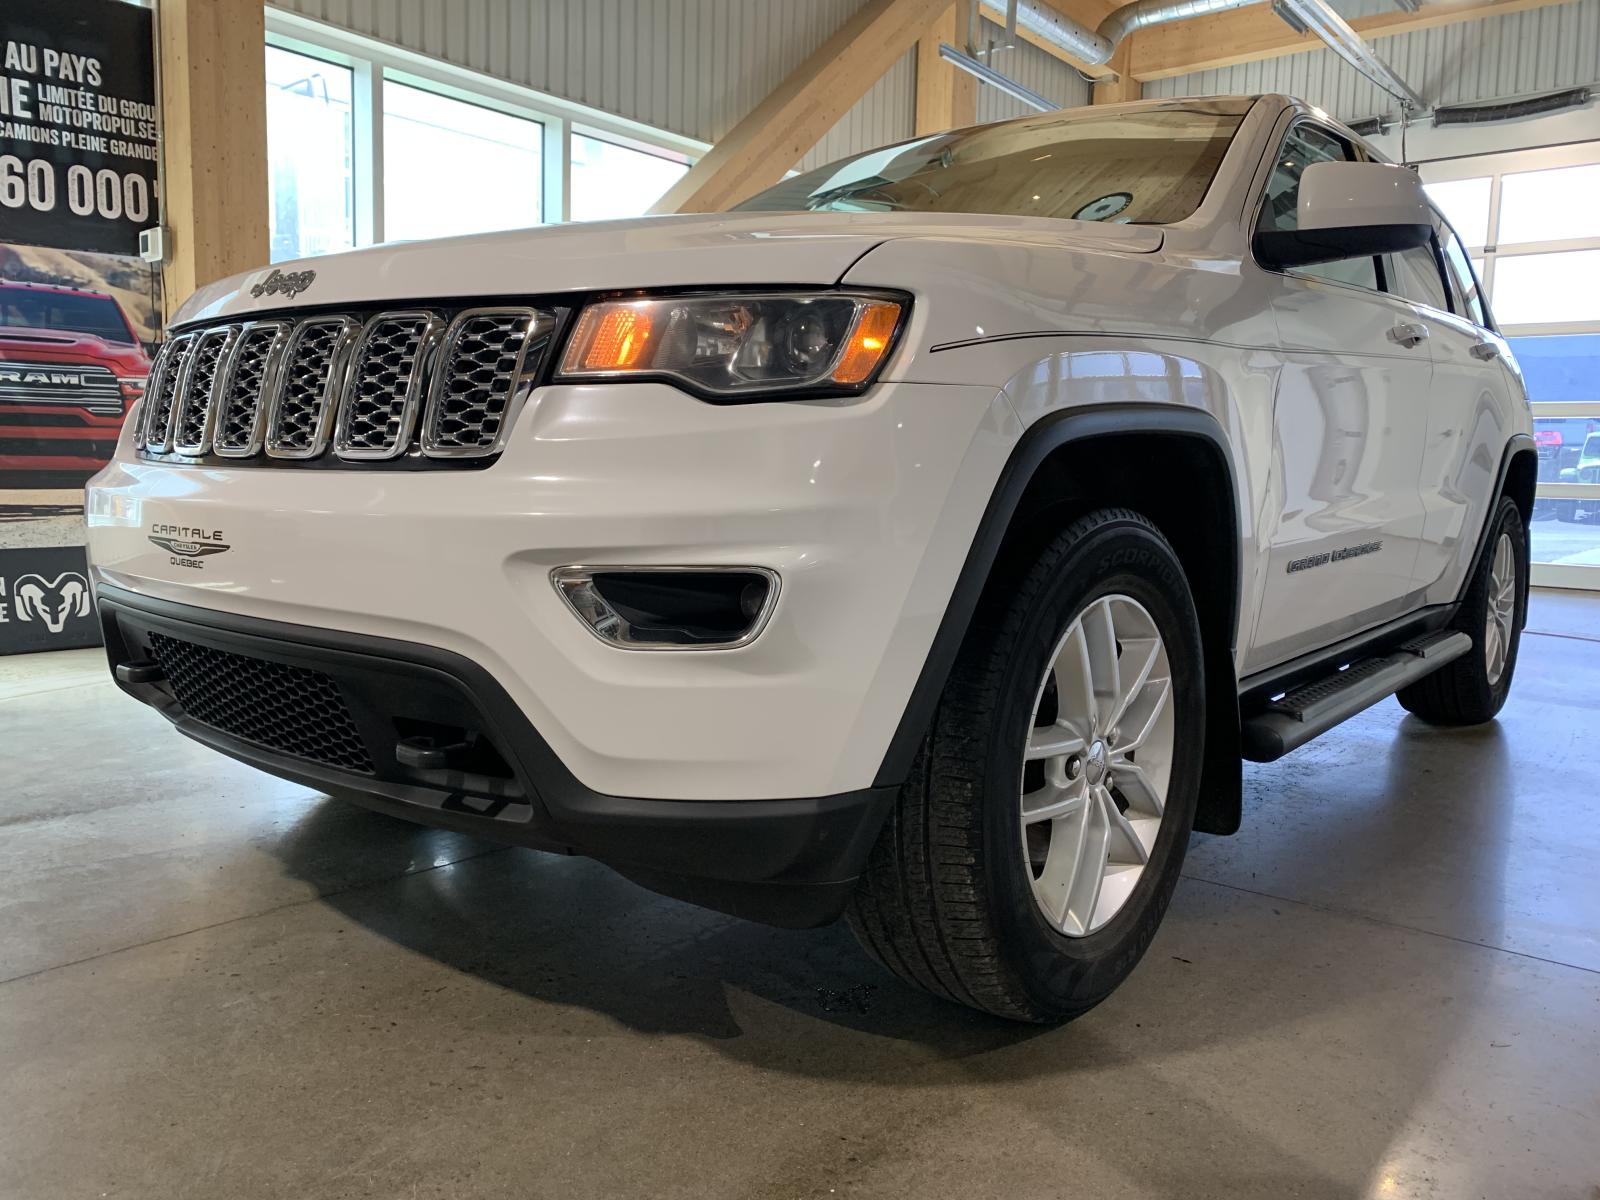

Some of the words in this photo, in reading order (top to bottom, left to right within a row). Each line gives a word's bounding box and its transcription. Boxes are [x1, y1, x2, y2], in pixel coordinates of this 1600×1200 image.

[5, 41, 37, 73] AU
[43, 48, 101, 86] PAYS
[37, 83, 95, 111] LIMITÉE
[98, 94, 117, 114] DU
[0, 120, 59, 146] CAMIONS
[62, 131, 108, 153] PLEINE
[0, 155, 55, 211] 60
[67, 164, 149, 223] 000
[250, 269, 316, 300] Jeep
[0, 371, 79, 384] RAM
[152, 524, 223, 541] CAPITALE
[170, 556, 204, 569] QUEBEC
